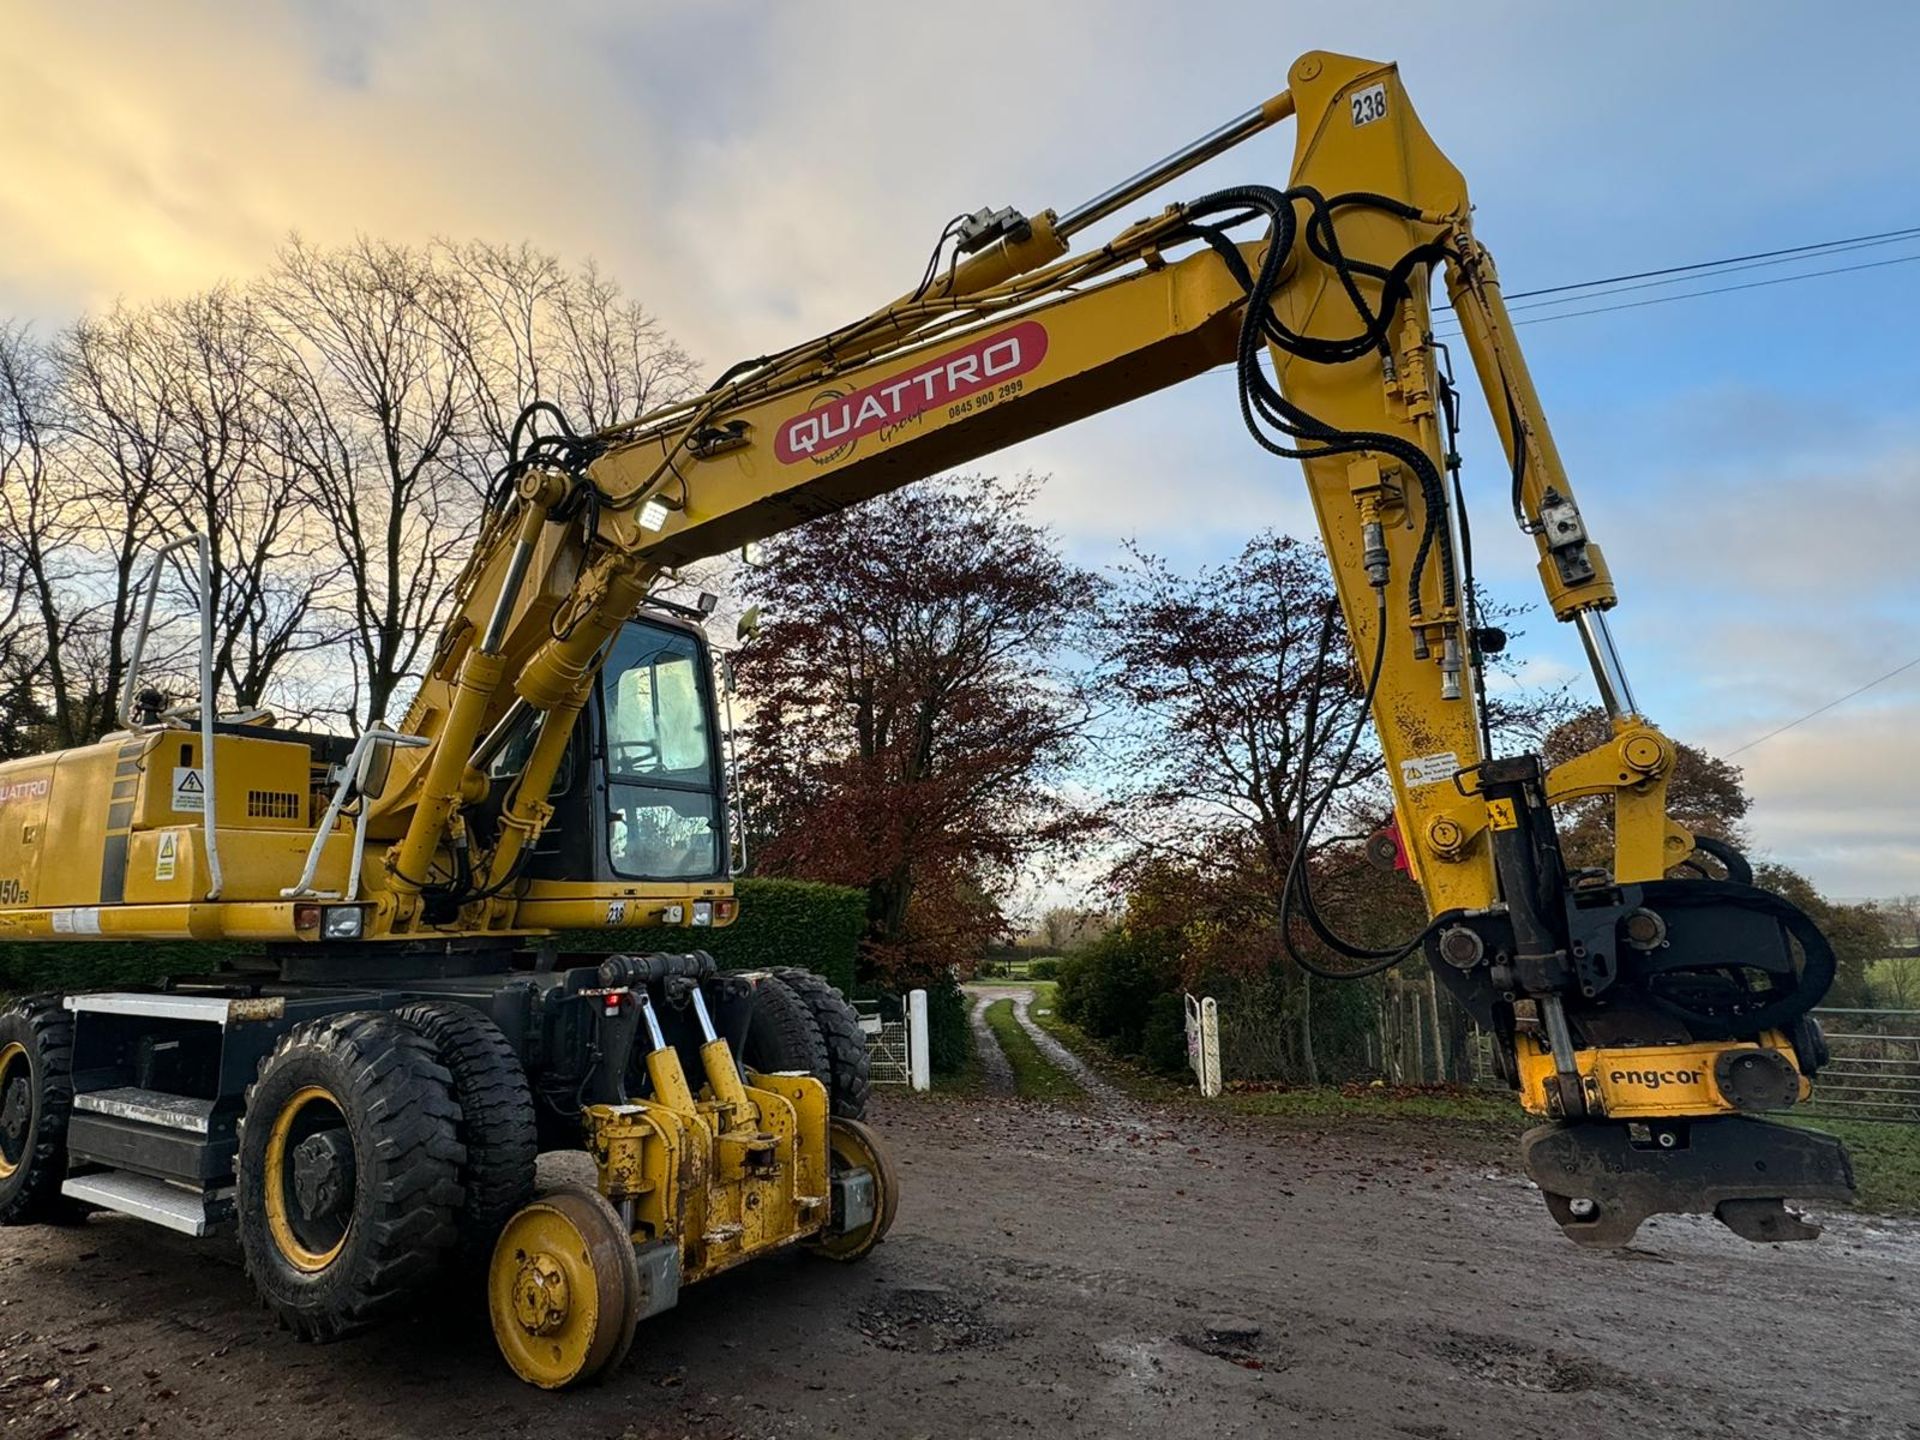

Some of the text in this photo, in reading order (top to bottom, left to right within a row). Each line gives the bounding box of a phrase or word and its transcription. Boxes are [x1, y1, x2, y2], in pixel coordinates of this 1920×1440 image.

[1353, 91, 1386, 125] 238
[788, 337, 1021, 452] QUATTRO
[949, 379, 1024, 419] 0845 900 2999
[0, 779, 48, 801] UATTRO
[607, 905, 625, 924] 238
